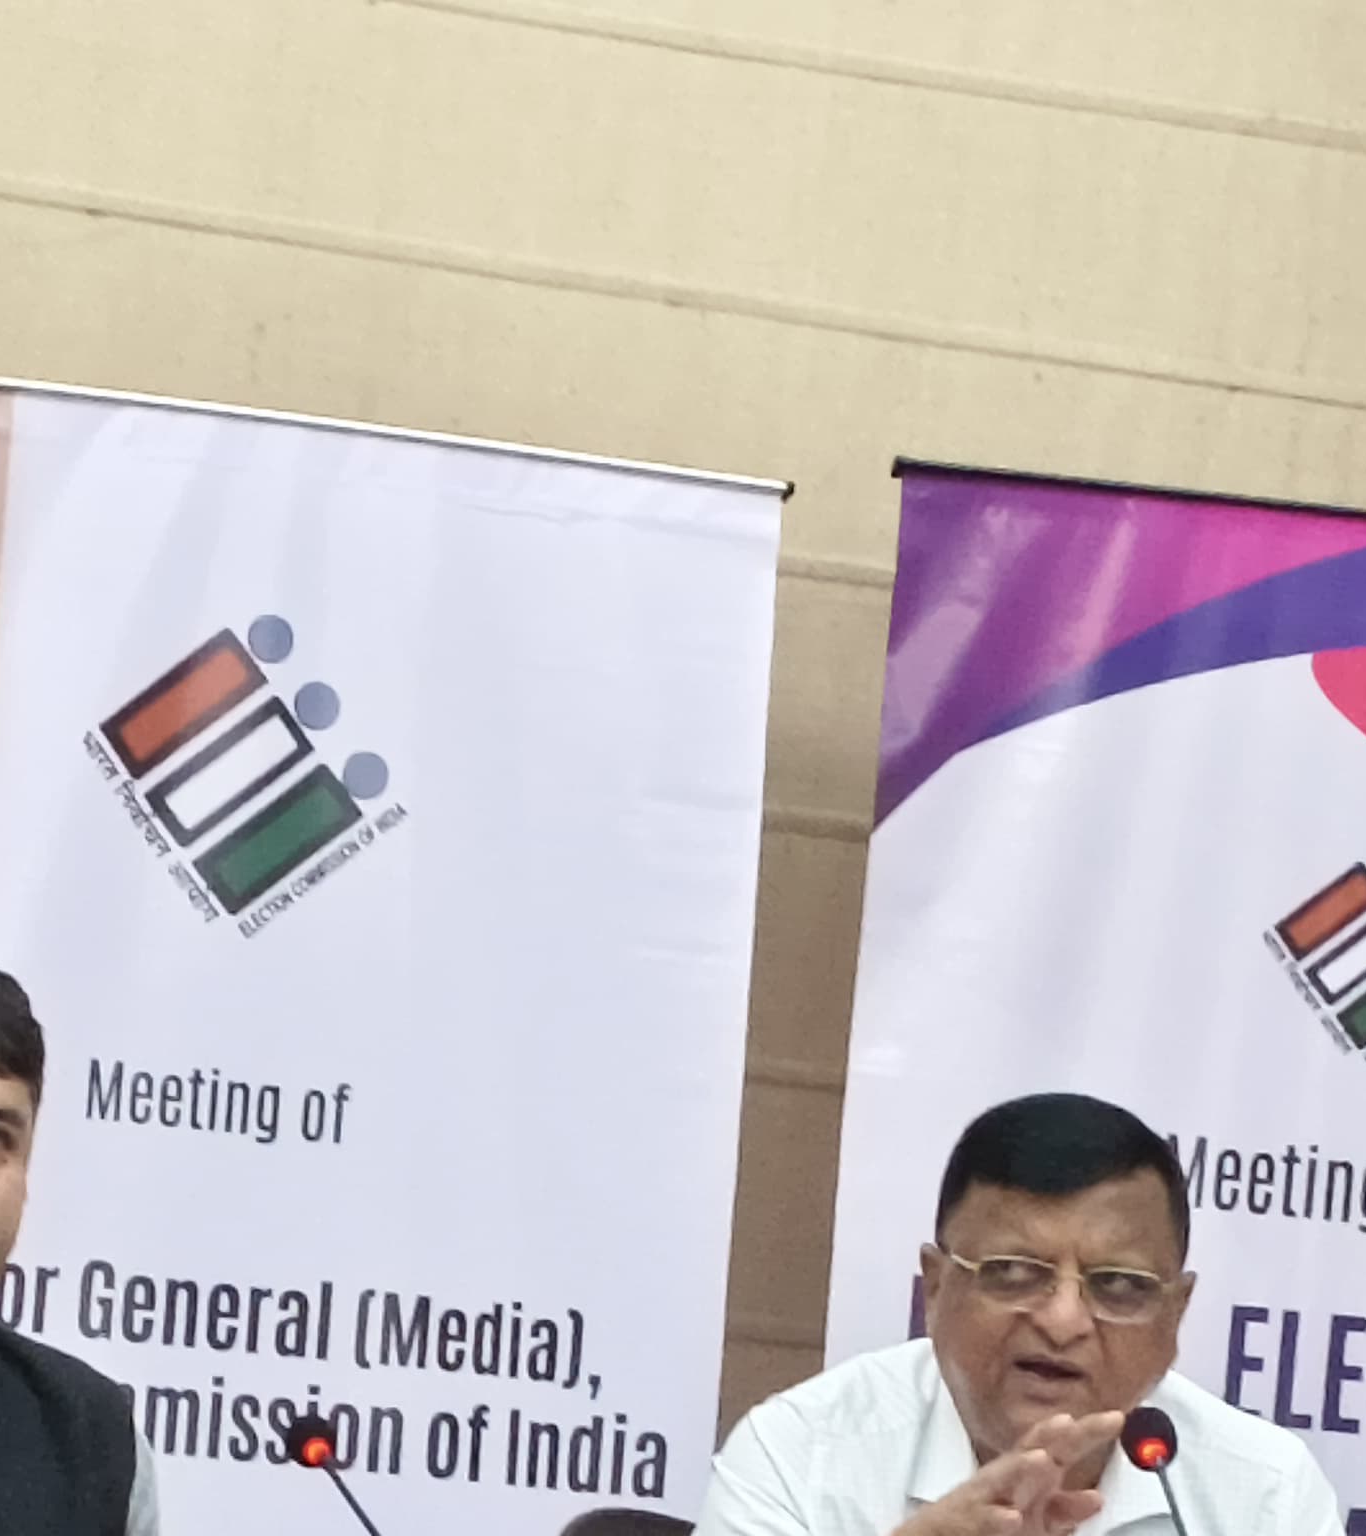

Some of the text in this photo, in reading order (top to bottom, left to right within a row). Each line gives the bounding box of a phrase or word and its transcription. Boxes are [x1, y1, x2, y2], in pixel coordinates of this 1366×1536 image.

[85, 1058, 351, 1143] Meeting of
[78, 1259, 333, 1360] General
[355, 1288, 601, 1400] (Media),
[427, 1404, 489, 1482] of
[506, 1408, 668, 1499] India
